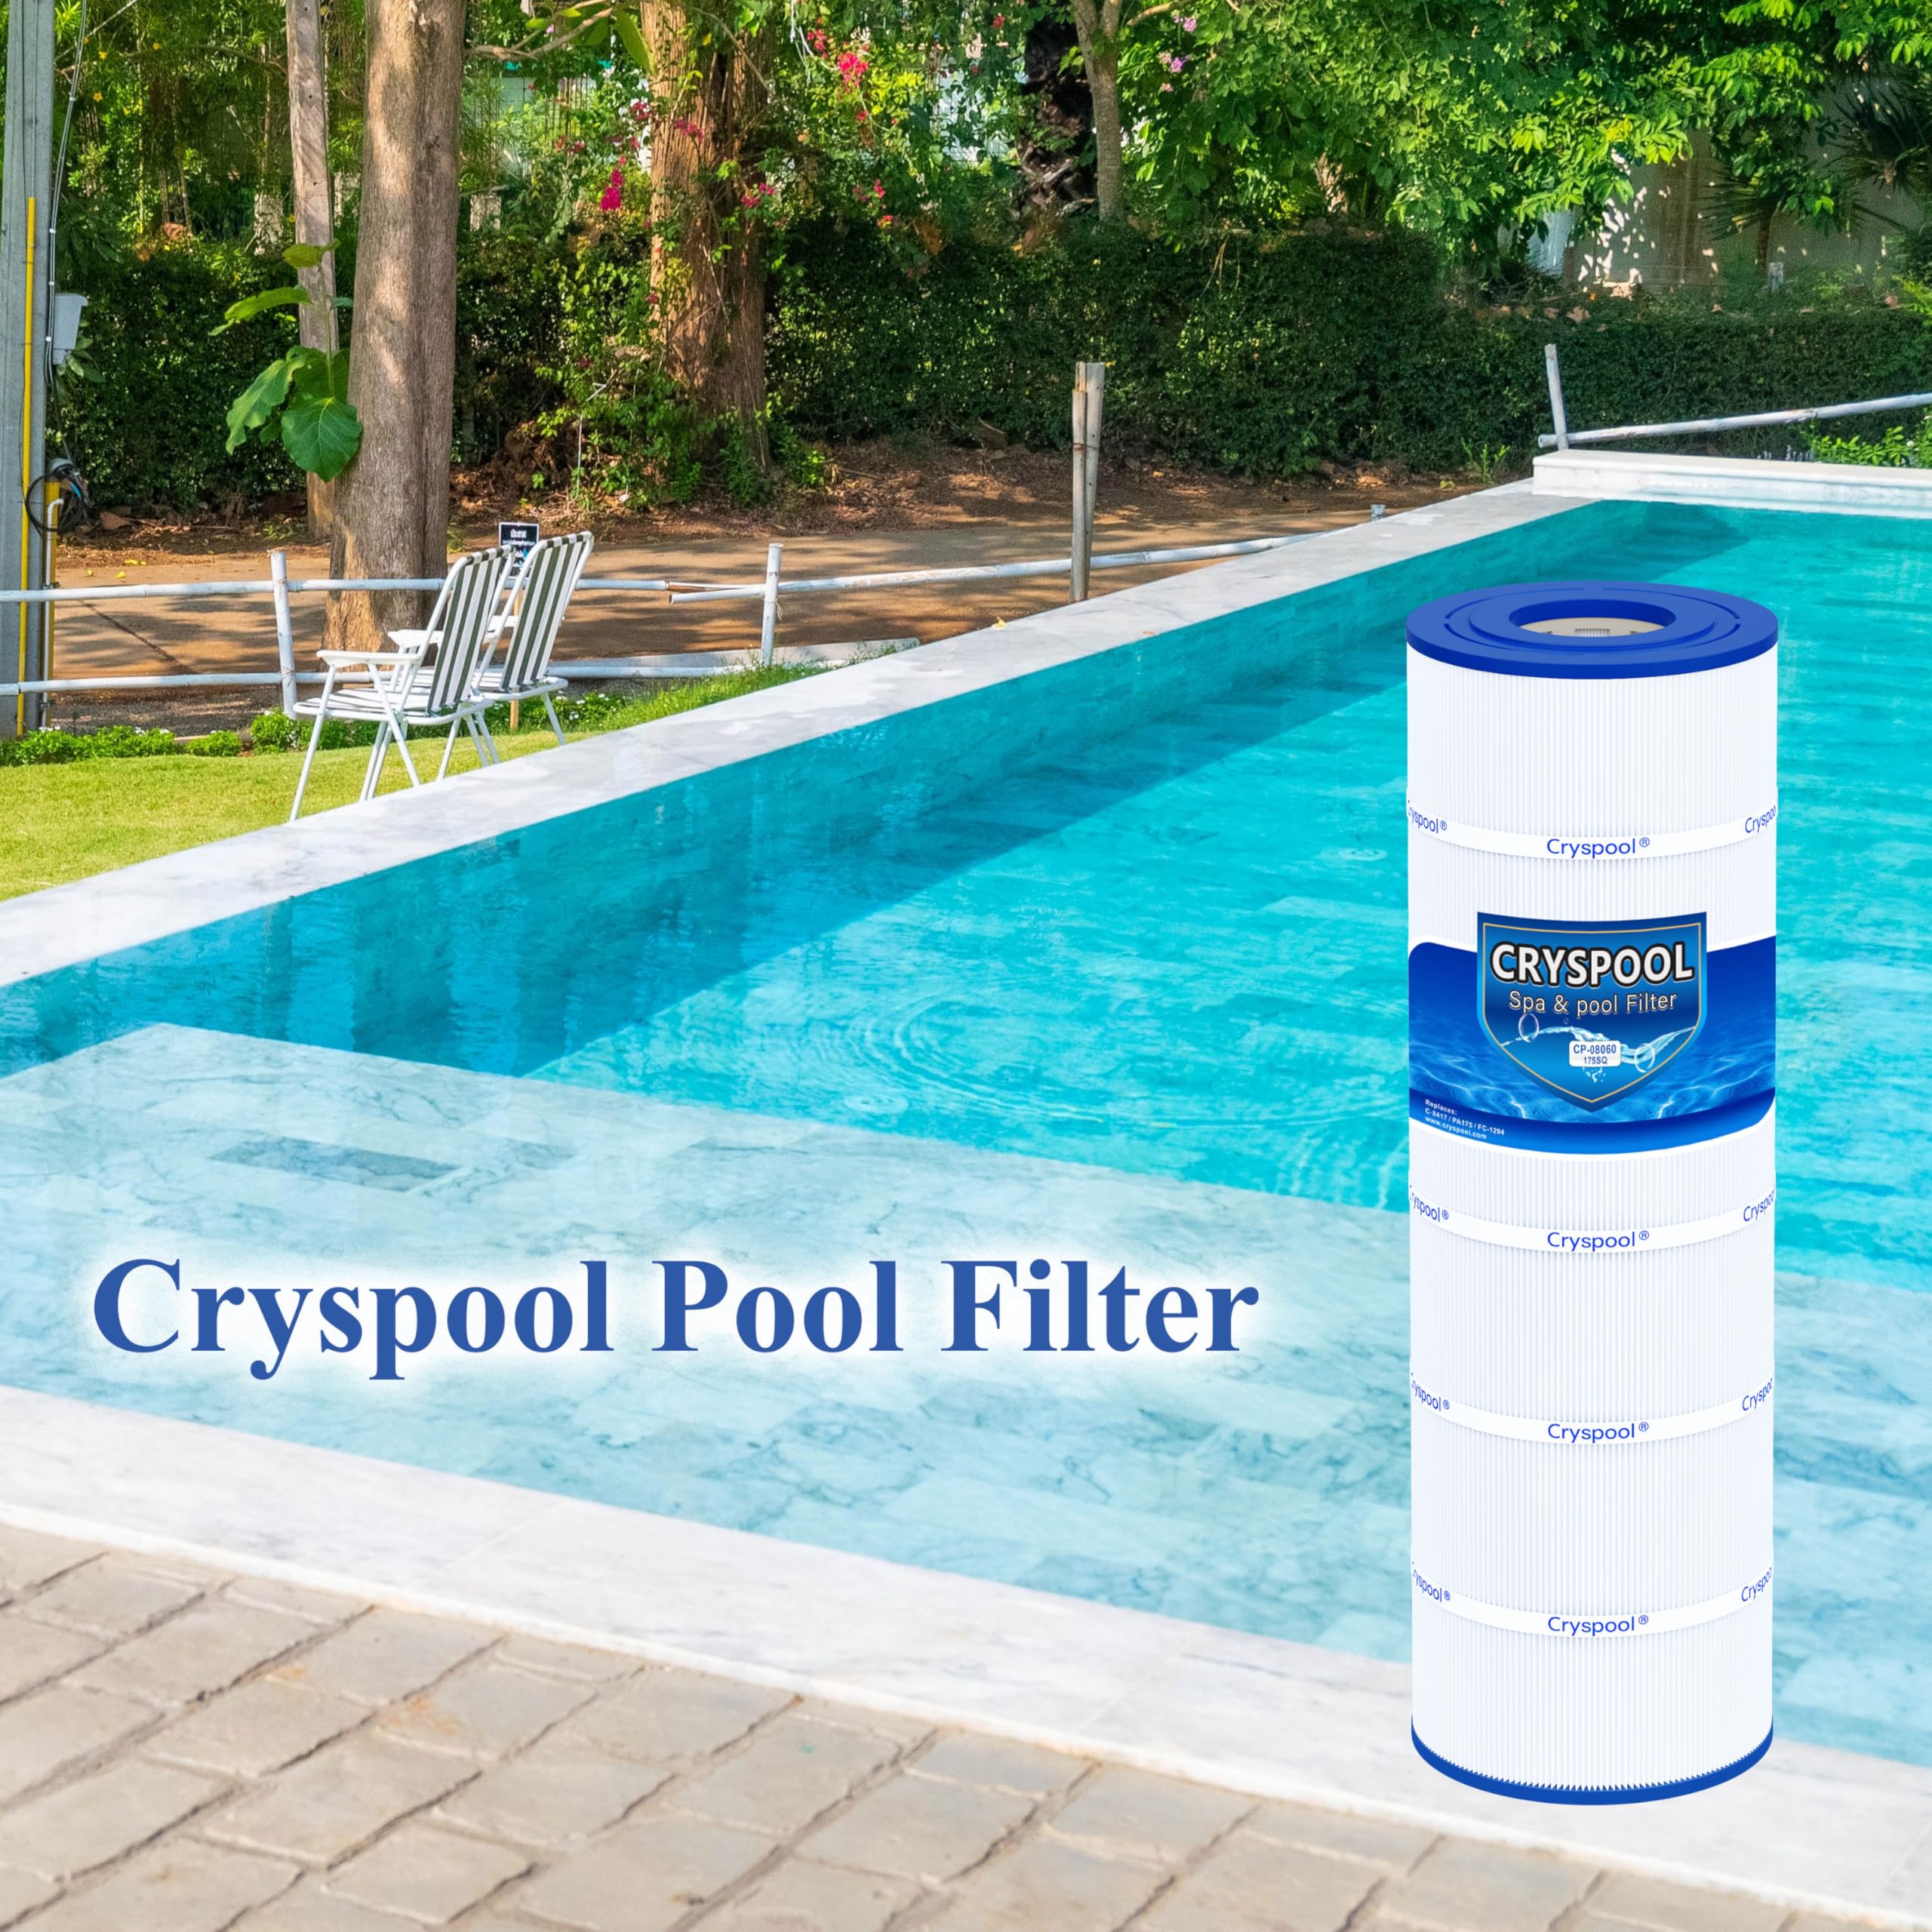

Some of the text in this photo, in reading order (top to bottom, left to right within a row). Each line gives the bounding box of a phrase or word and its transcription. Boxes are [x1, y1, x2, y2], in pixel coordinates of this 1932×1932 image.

[1491, 941, 1695, 987] CRYSPOOL
[1509, 990, 1677, 1019] Spa & pool Filter
[1573, 1044, 1617, 1054] CP-08060
[1425, 1099, 1457, 1115] Replaces:
[1425, 1108, 1447, 1119] C-8417
[1452, 1117, 1473, 1128] PA175
[1478, 1124, 1505, 1135] FC-1294
[1425, 1116, 1487, 1140] www.cryspool.com
